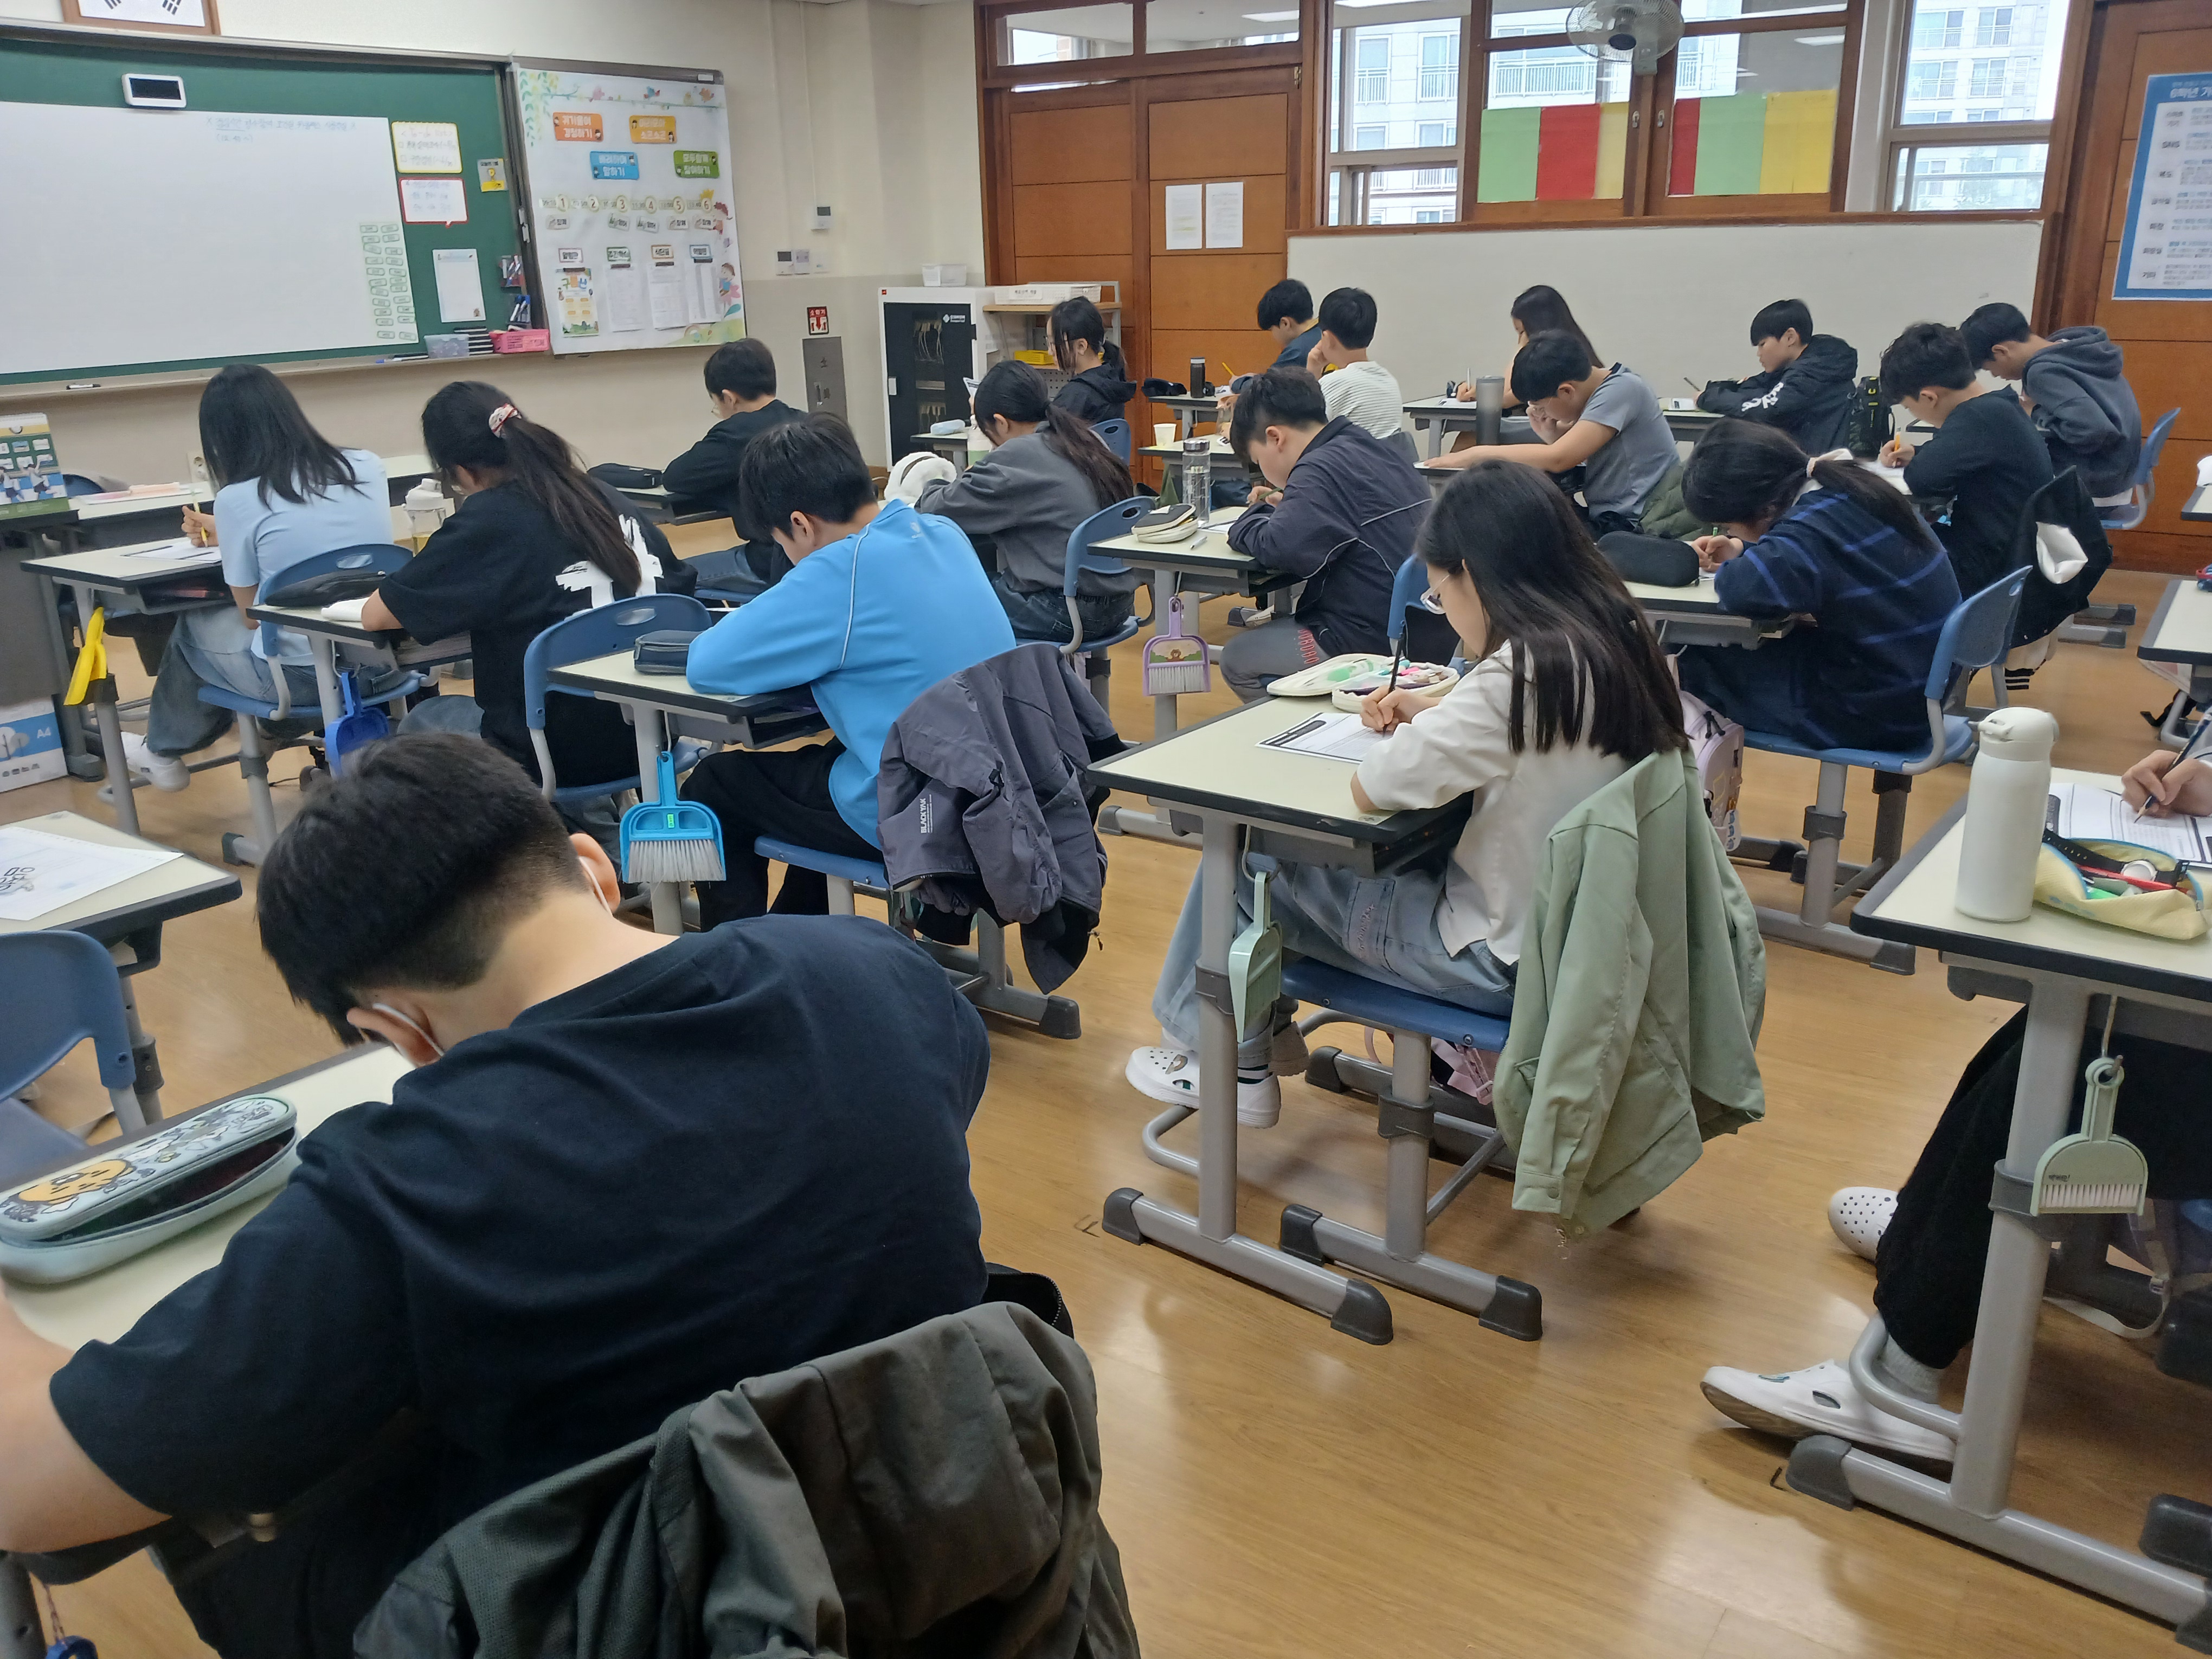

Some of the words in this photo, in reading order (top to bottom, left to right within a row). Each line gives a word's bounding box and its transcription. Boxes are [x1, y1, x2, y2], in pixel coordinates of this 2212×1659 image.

[561, 198, 565, 208] 1
[590, 198, 596, 208] 2
[620, 199, 625, 209] 3
[648, 201, 653, 210] 4
[676, 201, 681, 210] 5
[704, 200, 709, 210] 6
[37, 726, 52, 739] A4
